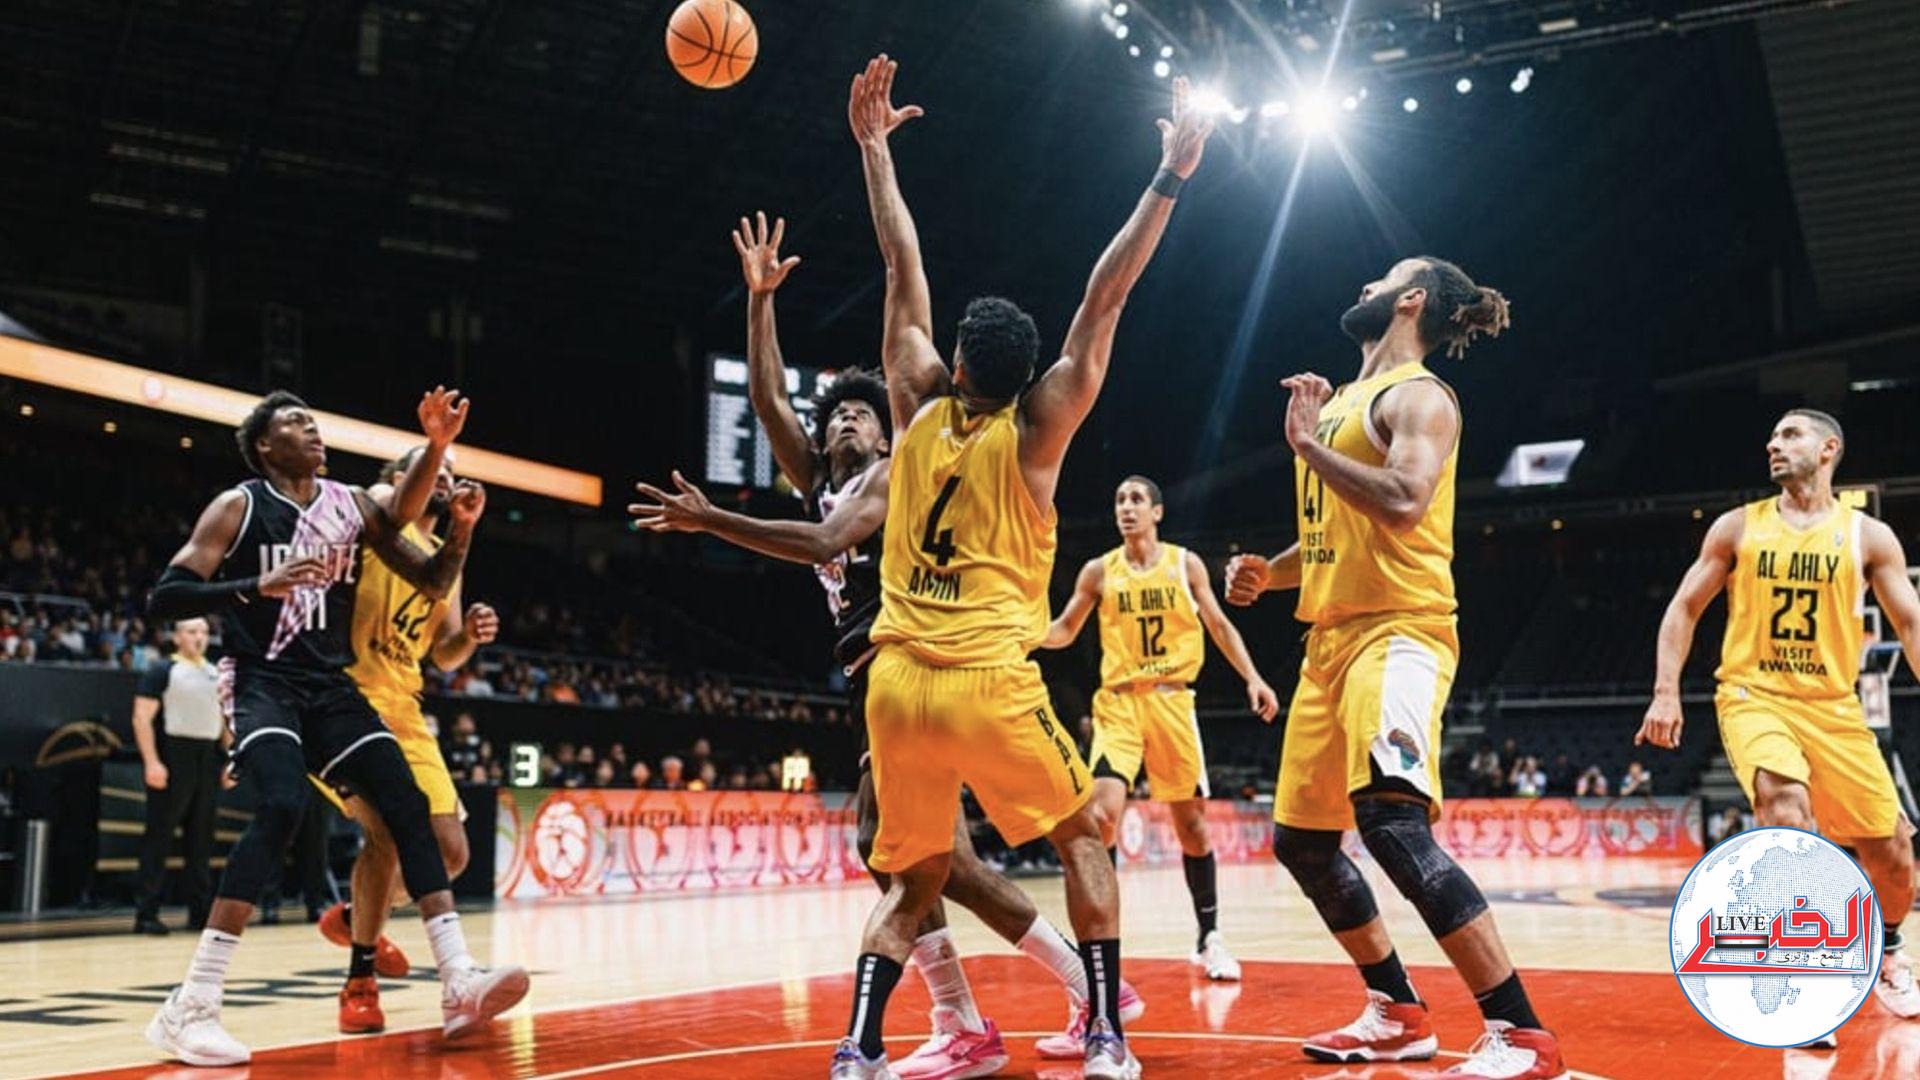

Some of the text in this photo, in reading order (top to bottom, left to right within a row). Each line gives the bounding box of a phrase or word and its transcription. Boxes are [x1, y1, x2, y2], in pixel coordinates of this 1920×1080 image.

[1304, 465, 1323, 524] 41
[921, 475, 962, 567] 4
[1305, 532, 1323, 546] IST
[909, 565, 961, 602] AMIN
[1757, 550, 1839, 584] AL AHLY
[302, 588, 327, 632] 11
[391, 590, 437, 641] 42
[1118, 586, 1176, 613] AL AHLY
[1770, 586, 1818, 641] 23
[1136, 615, 1166, 657] 12
[1772, 646, 1813, 660] VISIT
[1759, 659, 1827, 676] RWANDA
[515, 745, 539, 787] 3
[1035, 708, 1083, 795] BAL
